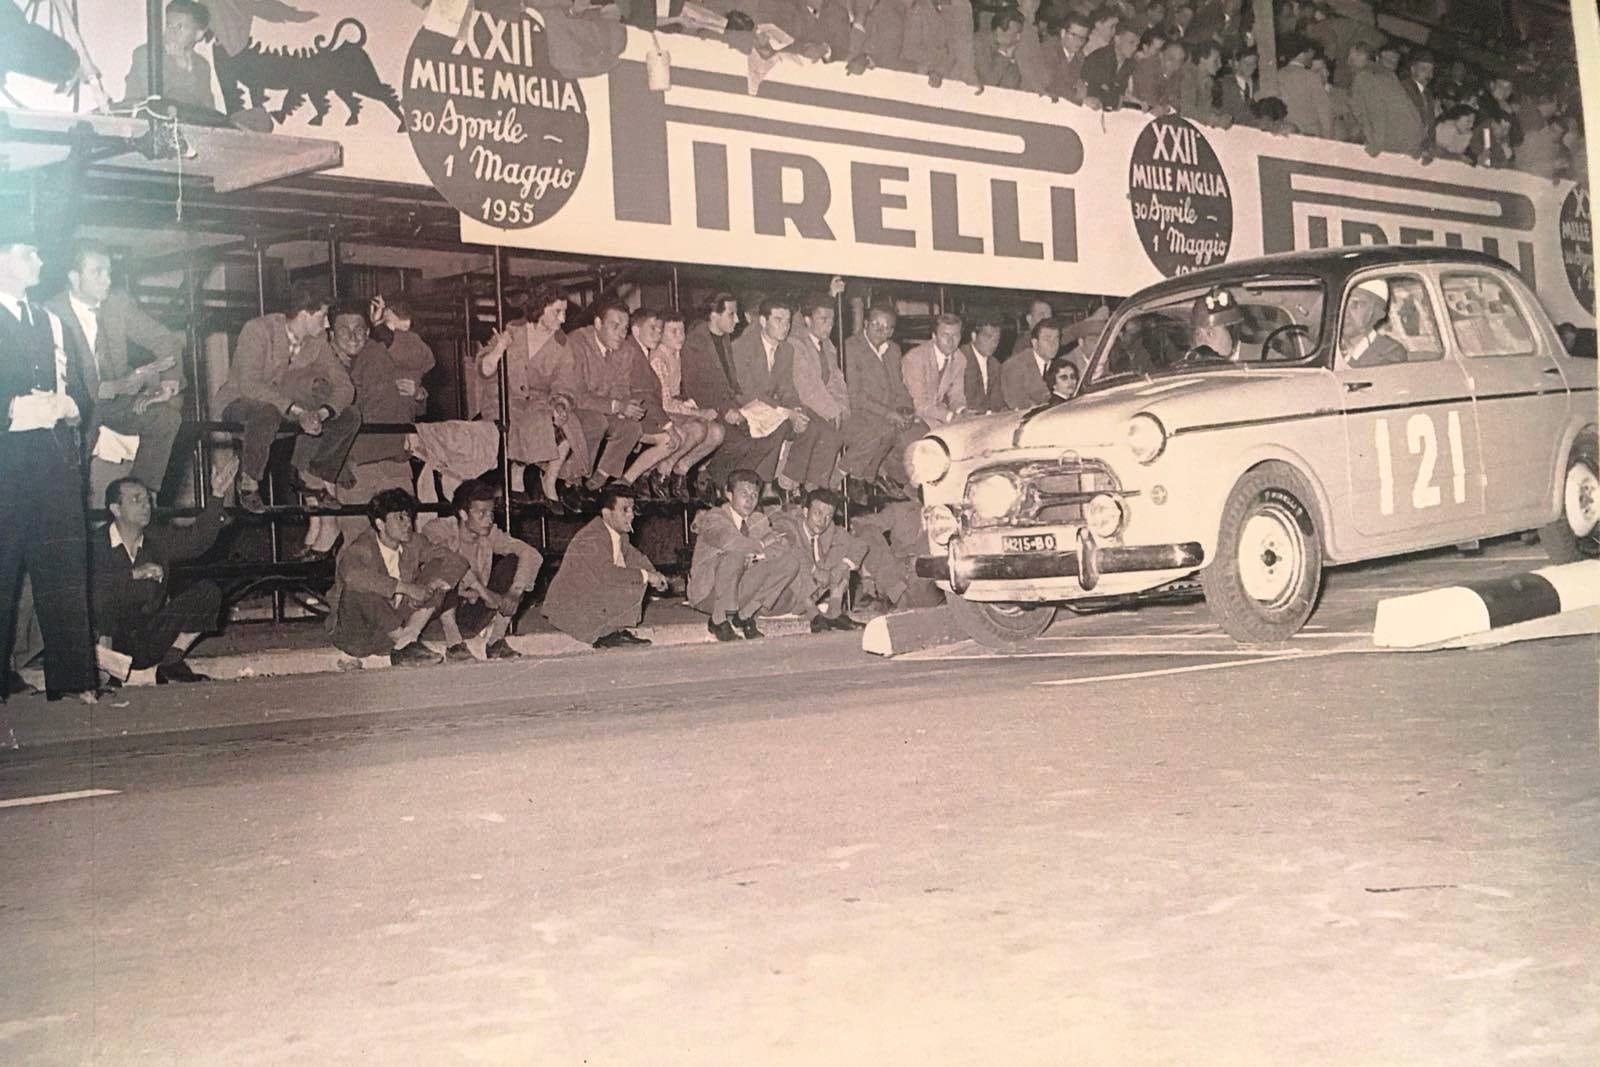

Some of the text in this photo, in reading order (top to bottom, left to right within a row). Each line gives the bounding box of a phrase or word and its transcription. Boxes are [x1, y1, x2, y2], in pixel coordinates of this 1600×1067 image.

[410, 58, 581, 114] MILLE MIGLIA
[410, 109, 435, 133] 30
[437, 99, 528, 150] Aprile
[443, 145, 576, 200] 1 Maggio
[608, 57, 1084, 263] PIRELLI
[1132, 164, 1227, 198] MILLE MIGLIA
[481, 197, 535, 224] 1955
[1134, 203, 1147, 220] 30
[1148, 193, 1198, 231] Aprile
[1152, 226, 1228, 265] 1 Maggio
[1375, 410, 1465, 517] 121
